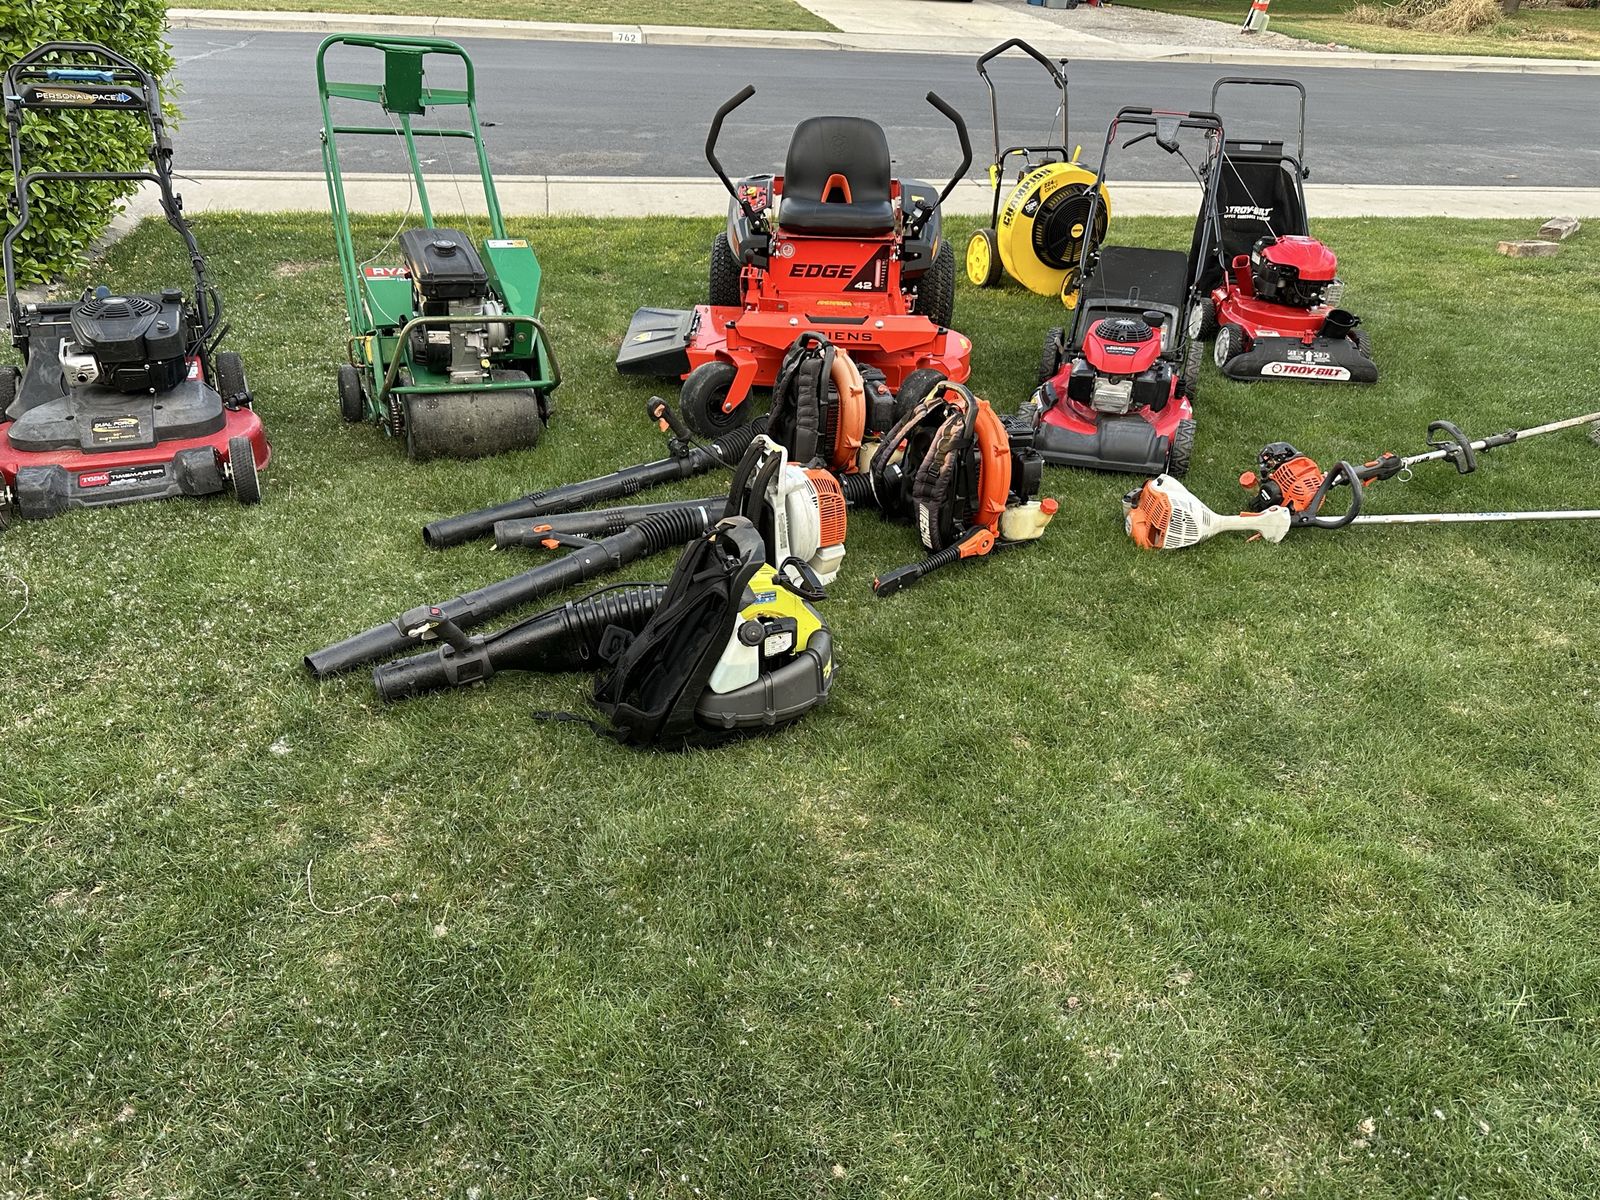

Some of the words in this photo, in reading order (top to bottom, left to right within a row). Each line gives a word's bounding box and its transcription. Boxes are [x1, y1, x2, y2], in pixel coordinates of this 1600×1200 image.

[618, 33, 636, 42] 762
[36, 92, 90, 101] PERSONAL
[92, 93, 116, 101] PACE
[1003, 168, 1052, 226] CHAMPION
[1229, 205, 1274, 216] TROY-BILT
[372, 267, 411, 276] RYA
[789, 263, 857, 279] EDGE
[854, 281, 873, 290] 42
[816, 331, 872, 342] IENS
[1283, 365, 1342, 377] TROY-BILT
[110, 469, 163, 479] TIMEMASTER
